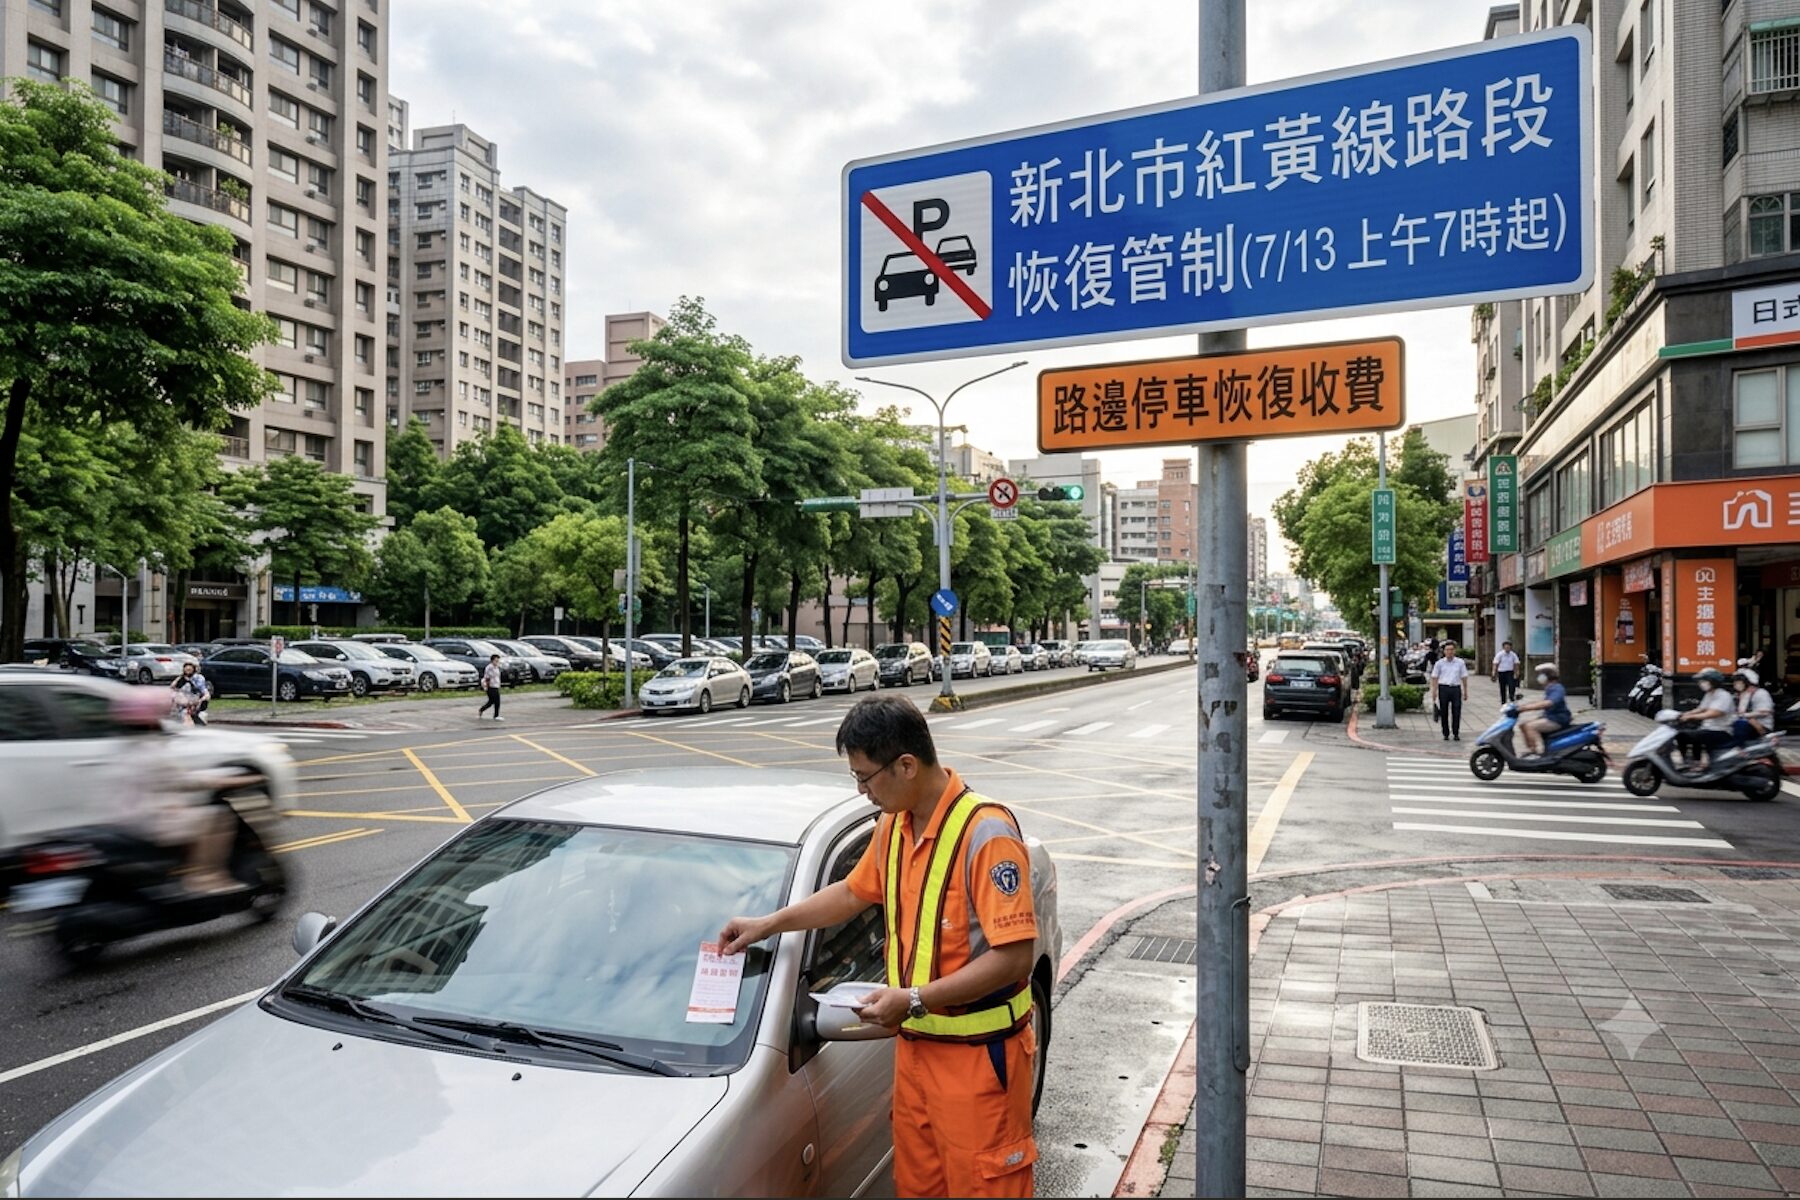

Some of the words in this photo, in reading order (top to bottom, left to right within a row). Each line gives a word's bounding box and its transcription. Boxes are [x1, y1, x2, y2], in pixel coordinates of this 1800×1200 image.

[1009, 73, 1554, 229] 新北市紅黃線路段
[913, 198, 950, 244] P
[1008, 223, 1336, 317] 恢復管制(7/13
[1347, 193, 1567, 272] 上午7時起)
[1053, 356, 1385, 435] 路邊停車恢復收費
